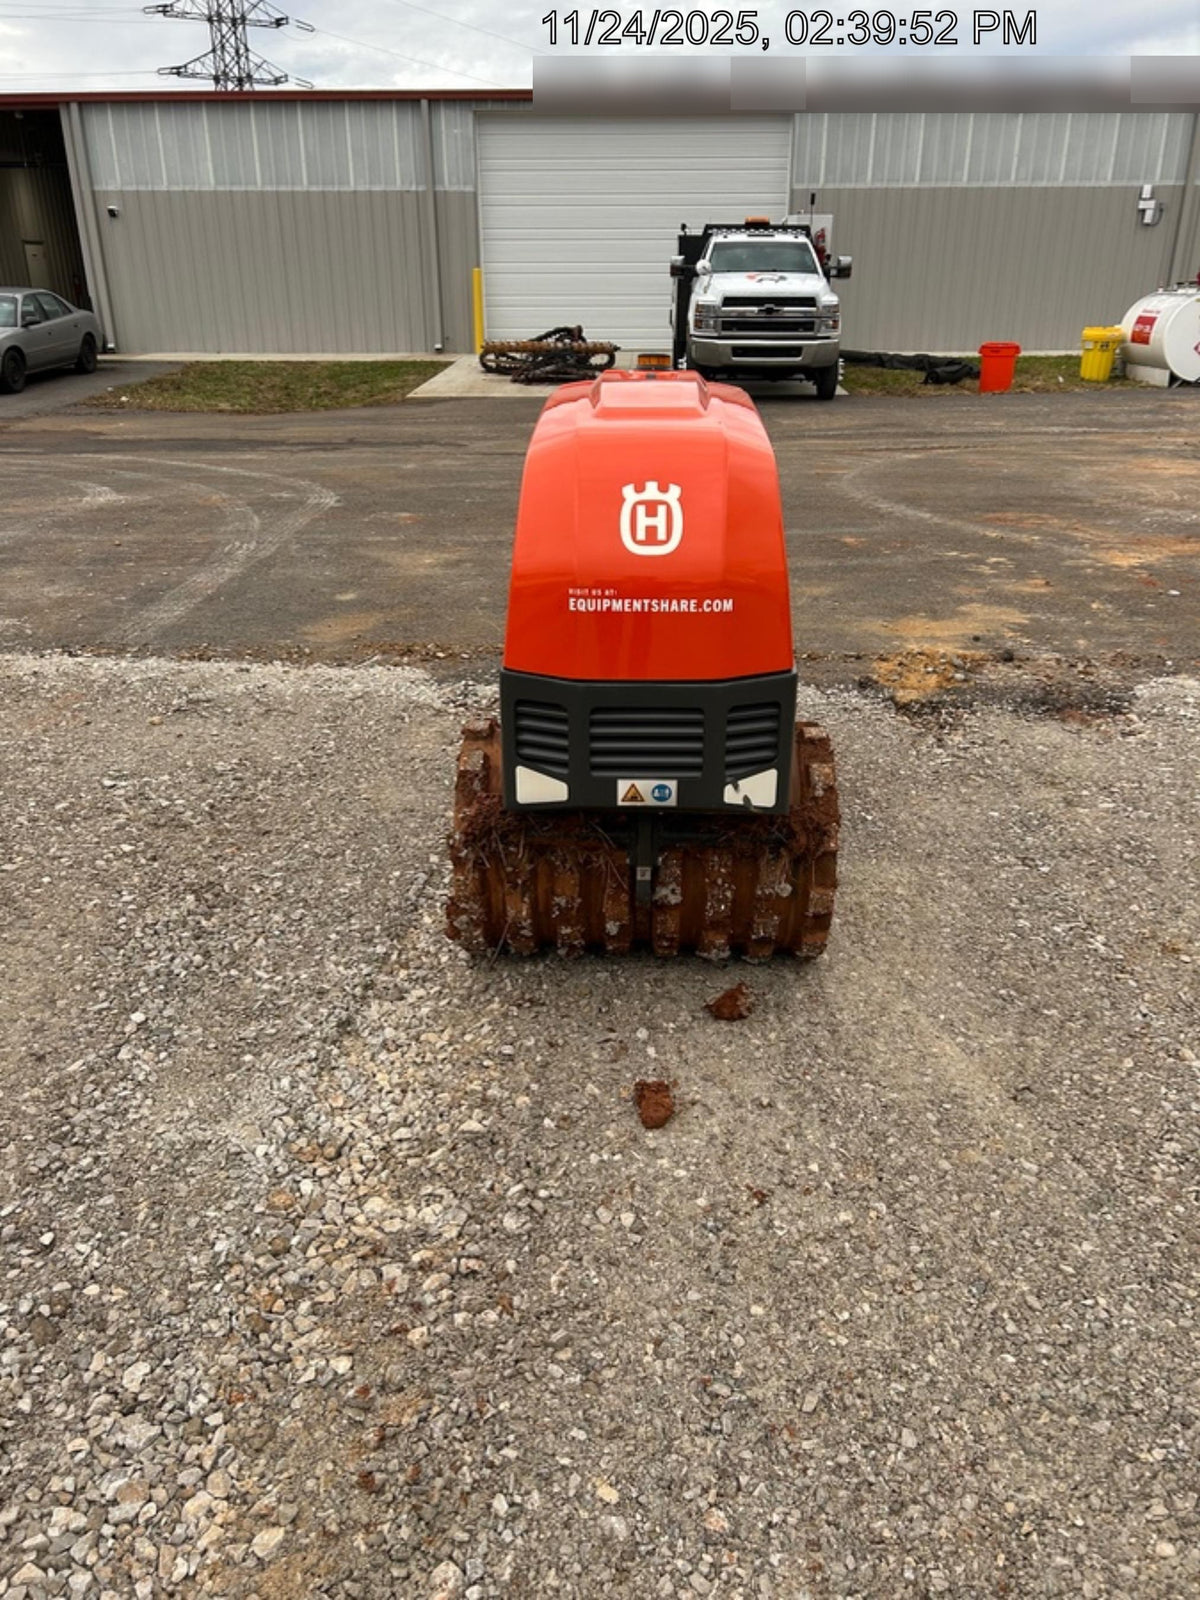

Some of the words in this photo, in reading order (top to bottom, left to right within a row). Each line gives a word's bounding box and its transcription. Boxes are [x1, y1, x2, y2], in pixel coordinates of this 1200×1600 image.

[635, 504, 668, 541] H
[568, 588, 589, 596] VISIT
[591, 588, 602, 596] US
[568, 597, 734, 613] EQUIPMENTSHARE.COM
